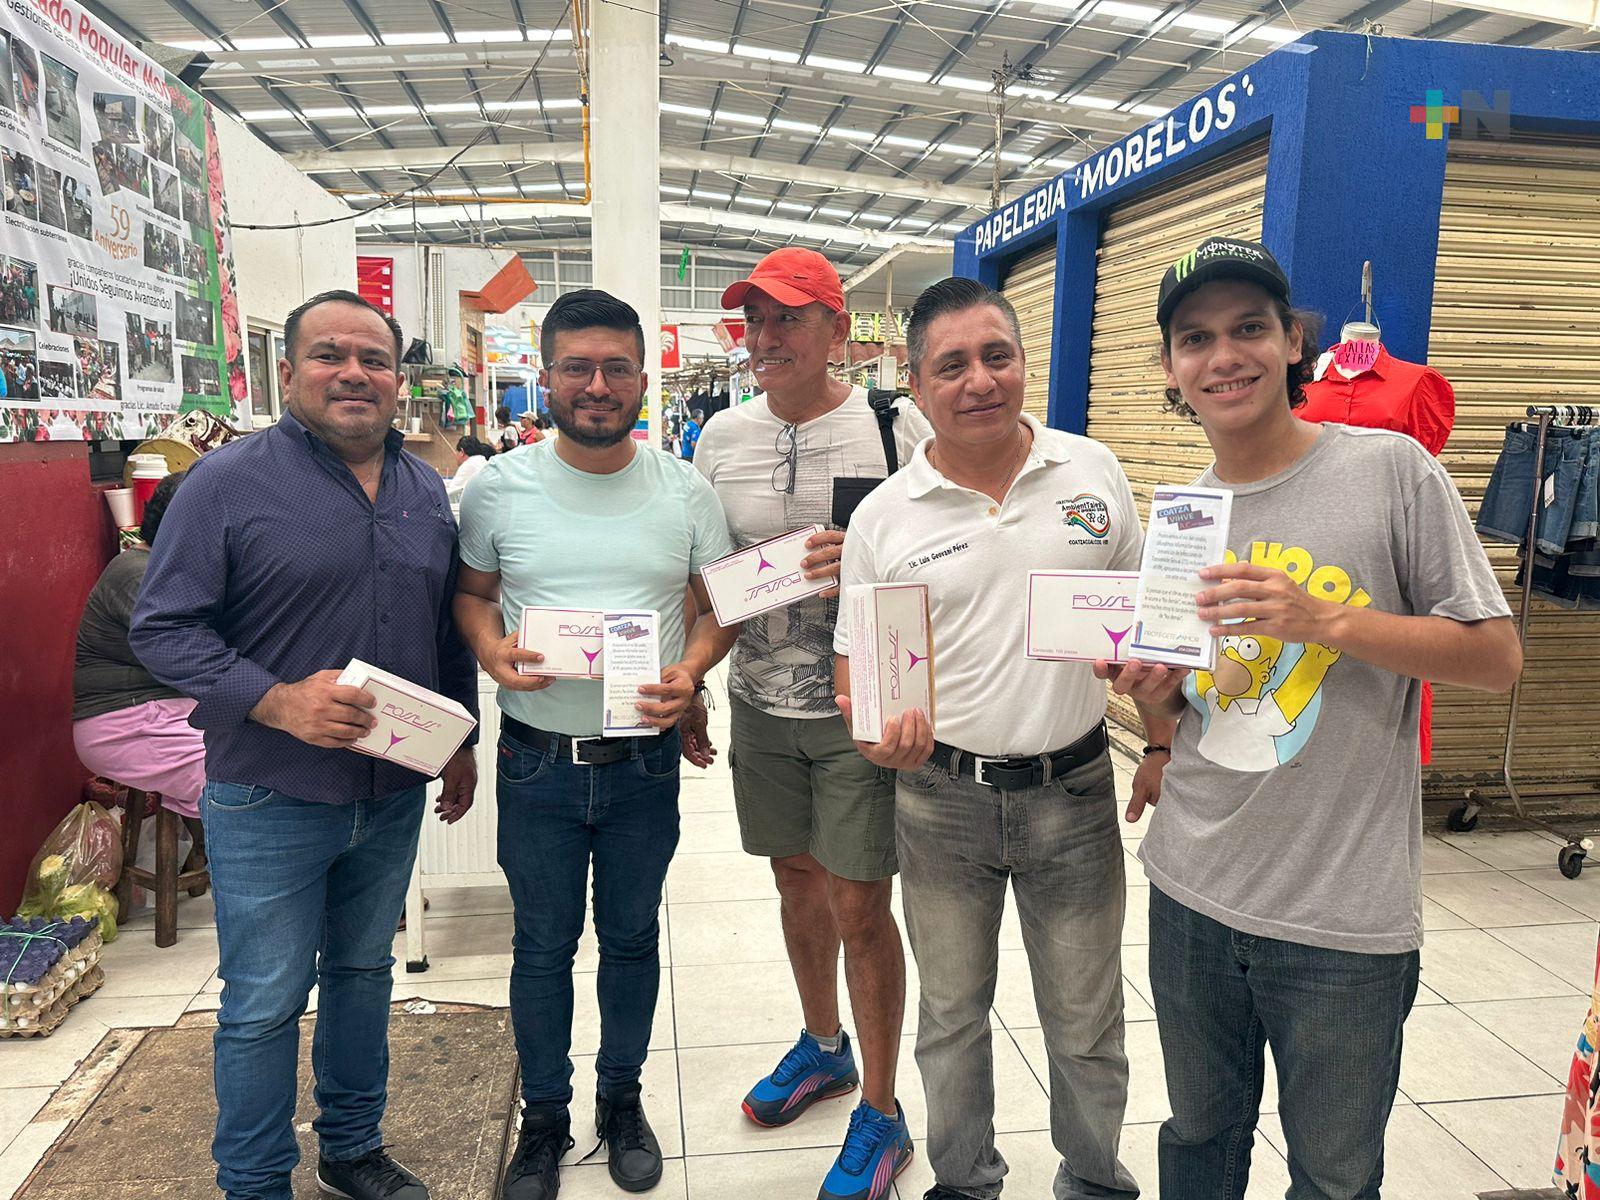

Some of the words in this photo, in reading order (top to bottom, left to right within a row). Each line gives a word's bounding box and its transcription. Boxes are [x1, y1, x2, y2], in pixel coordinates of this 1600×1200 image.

[6, 0, 53, 33] Gestiones
[79, 13, 138, 80] Popular
[110, 204, 131, 241] 59
[974, 177, 1067, 256] PAPELERIA
[95, 229, 138, 260] Aniversario
[1196, 241, 1264, 260] MONSTER
[99, 278, 133, 300] Seguimos
[134, 290, 173, 310] Avanzando!
[38, 341, 70, 353] Celebraciones
[1343, 342, 1376, 353] TALLAS
[1337, 352, 1375, 365] EXTRAS
[1158, 505, 1190, 517] COATZA
[918, 555, 931, 565] Luis
[1072, 594, 1136, 609] POSSE
[558, 624, 604, 636] POSSE
